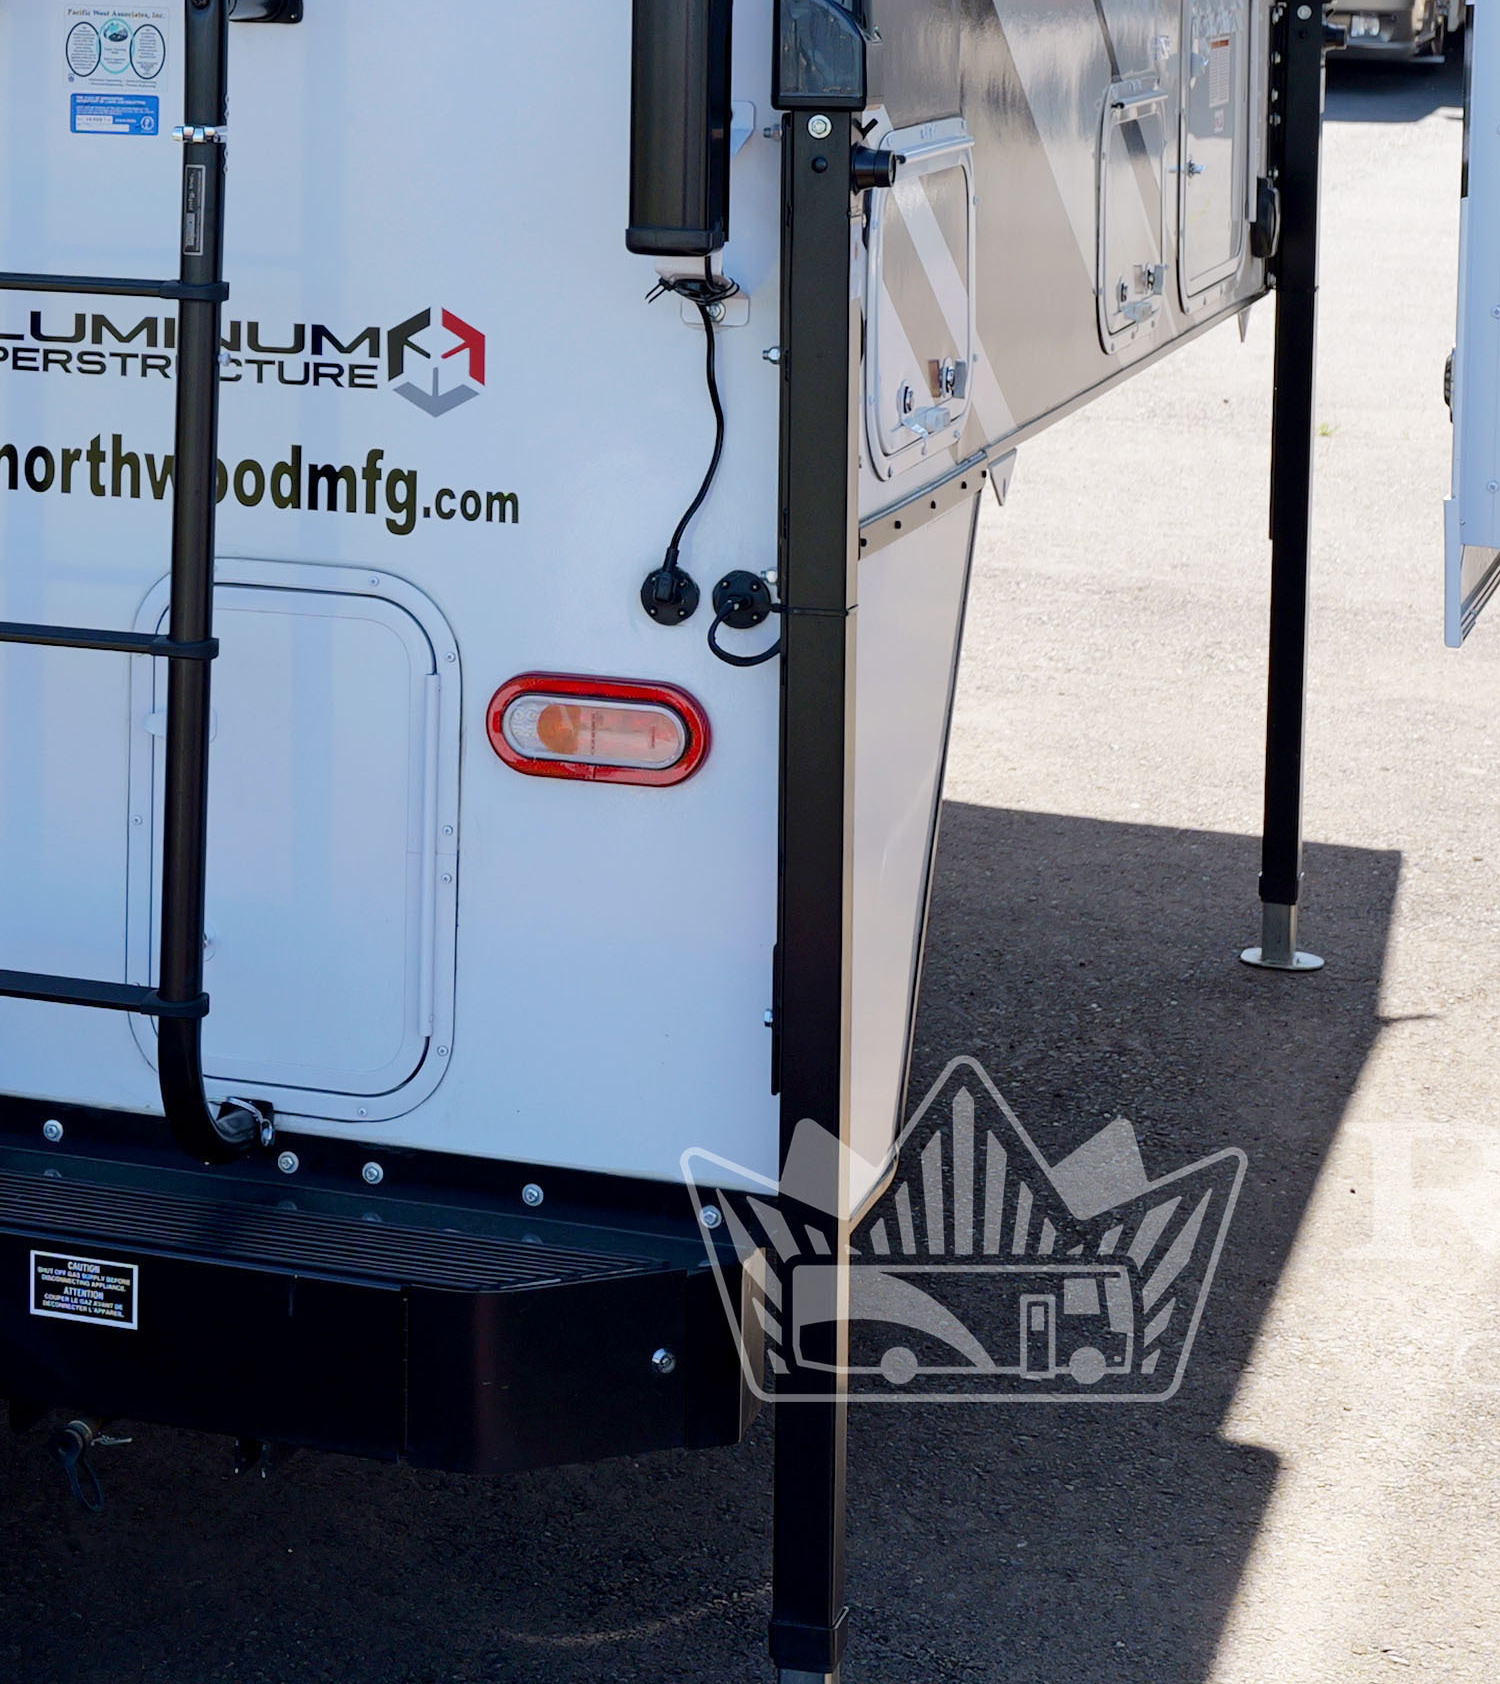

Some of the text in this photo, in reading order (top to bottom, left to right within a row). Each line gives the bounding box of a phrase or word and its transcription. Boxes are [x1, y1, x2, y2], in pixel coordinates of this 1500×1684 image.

[37, 1266, 53, 1274] SHUT
[81, 1273, 105, 1282] SUPPLY
[106, 1276, 130, 1286] BEFORE
[67, 1261, 100, 1274] CAUTION
[41, 1274, 126, 1292] DISCONNECTING APPLIANCE.
[44, 1293, 70, 1302] COUPER
[79, 1298, 92, 1306] GAZ
[93, 1300, 113, 1308] AVANT
[114, 1303, 123, 1311] DE
[63, 1286, 104, 1300] ATTENTION
